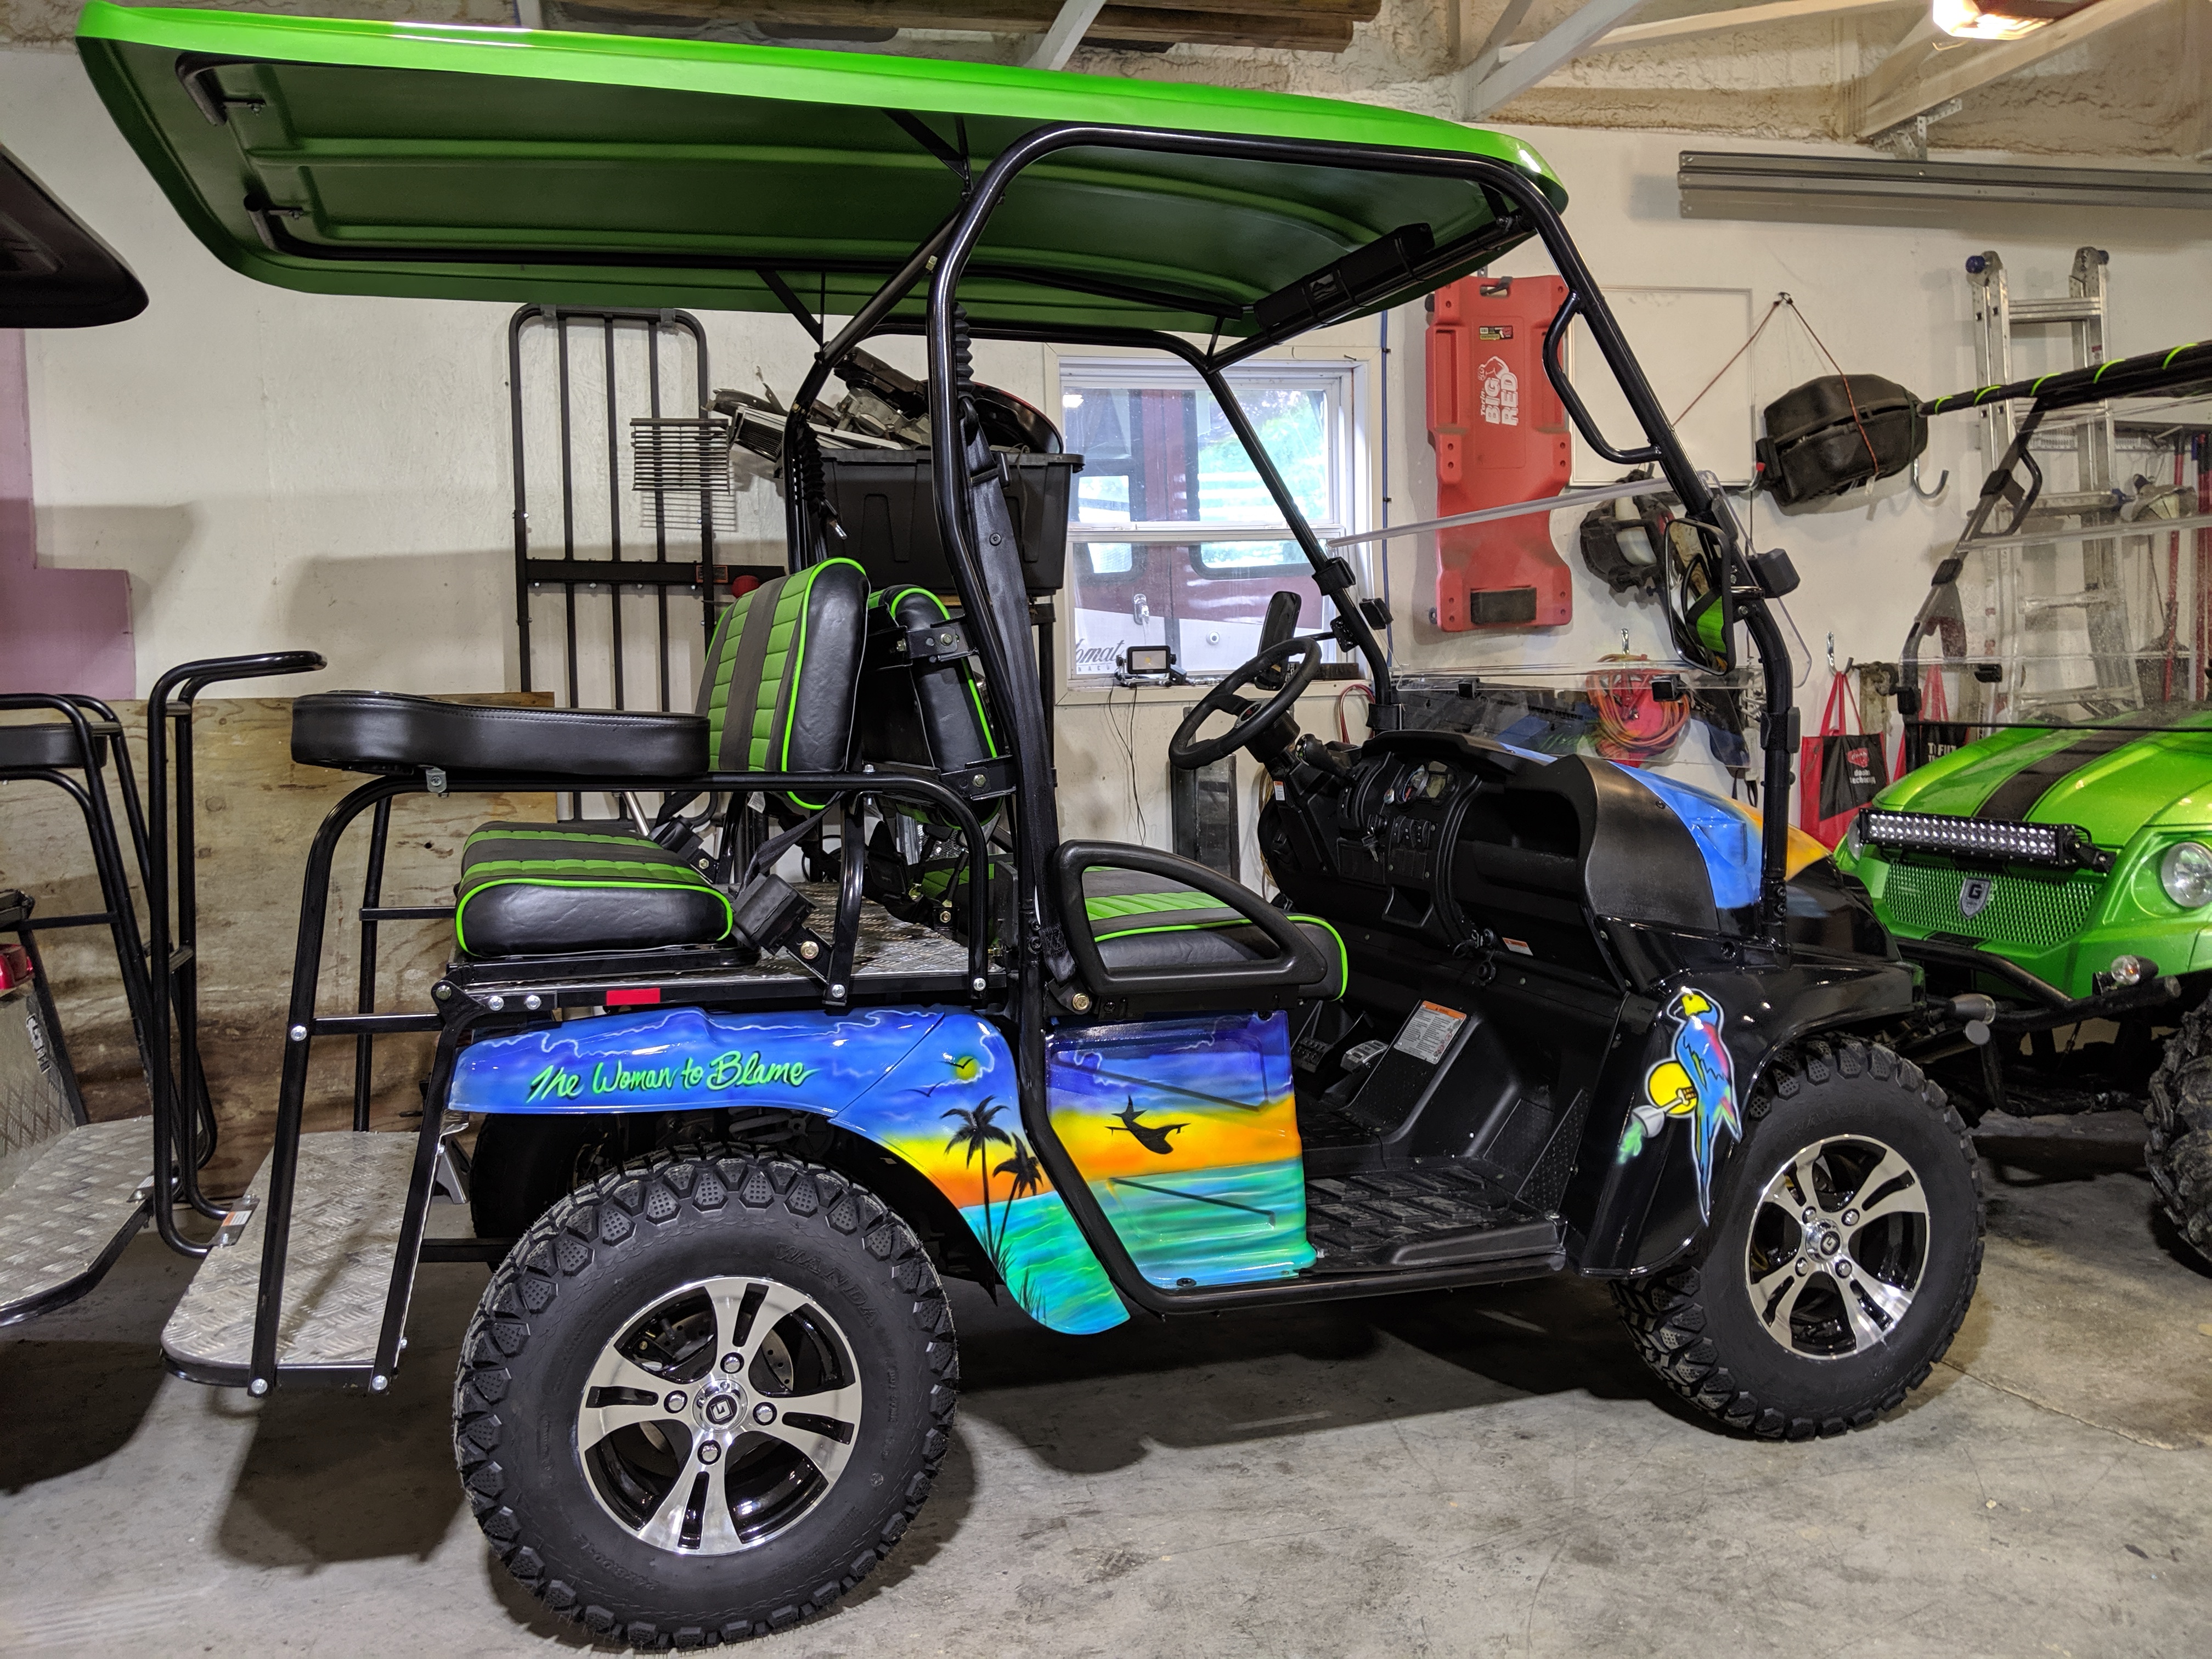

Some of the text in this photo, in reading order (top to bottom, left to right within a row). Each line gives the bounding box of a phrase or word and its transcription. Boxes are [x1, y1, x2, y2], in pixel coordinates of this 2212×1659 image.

[1485, 377, 1501, 425] BIG
[1500, 372, 1519, 426] RED
[526, 1050, 817, 1103] The Woman to Blame
[775, 1242, 881, 1328] WANDA
